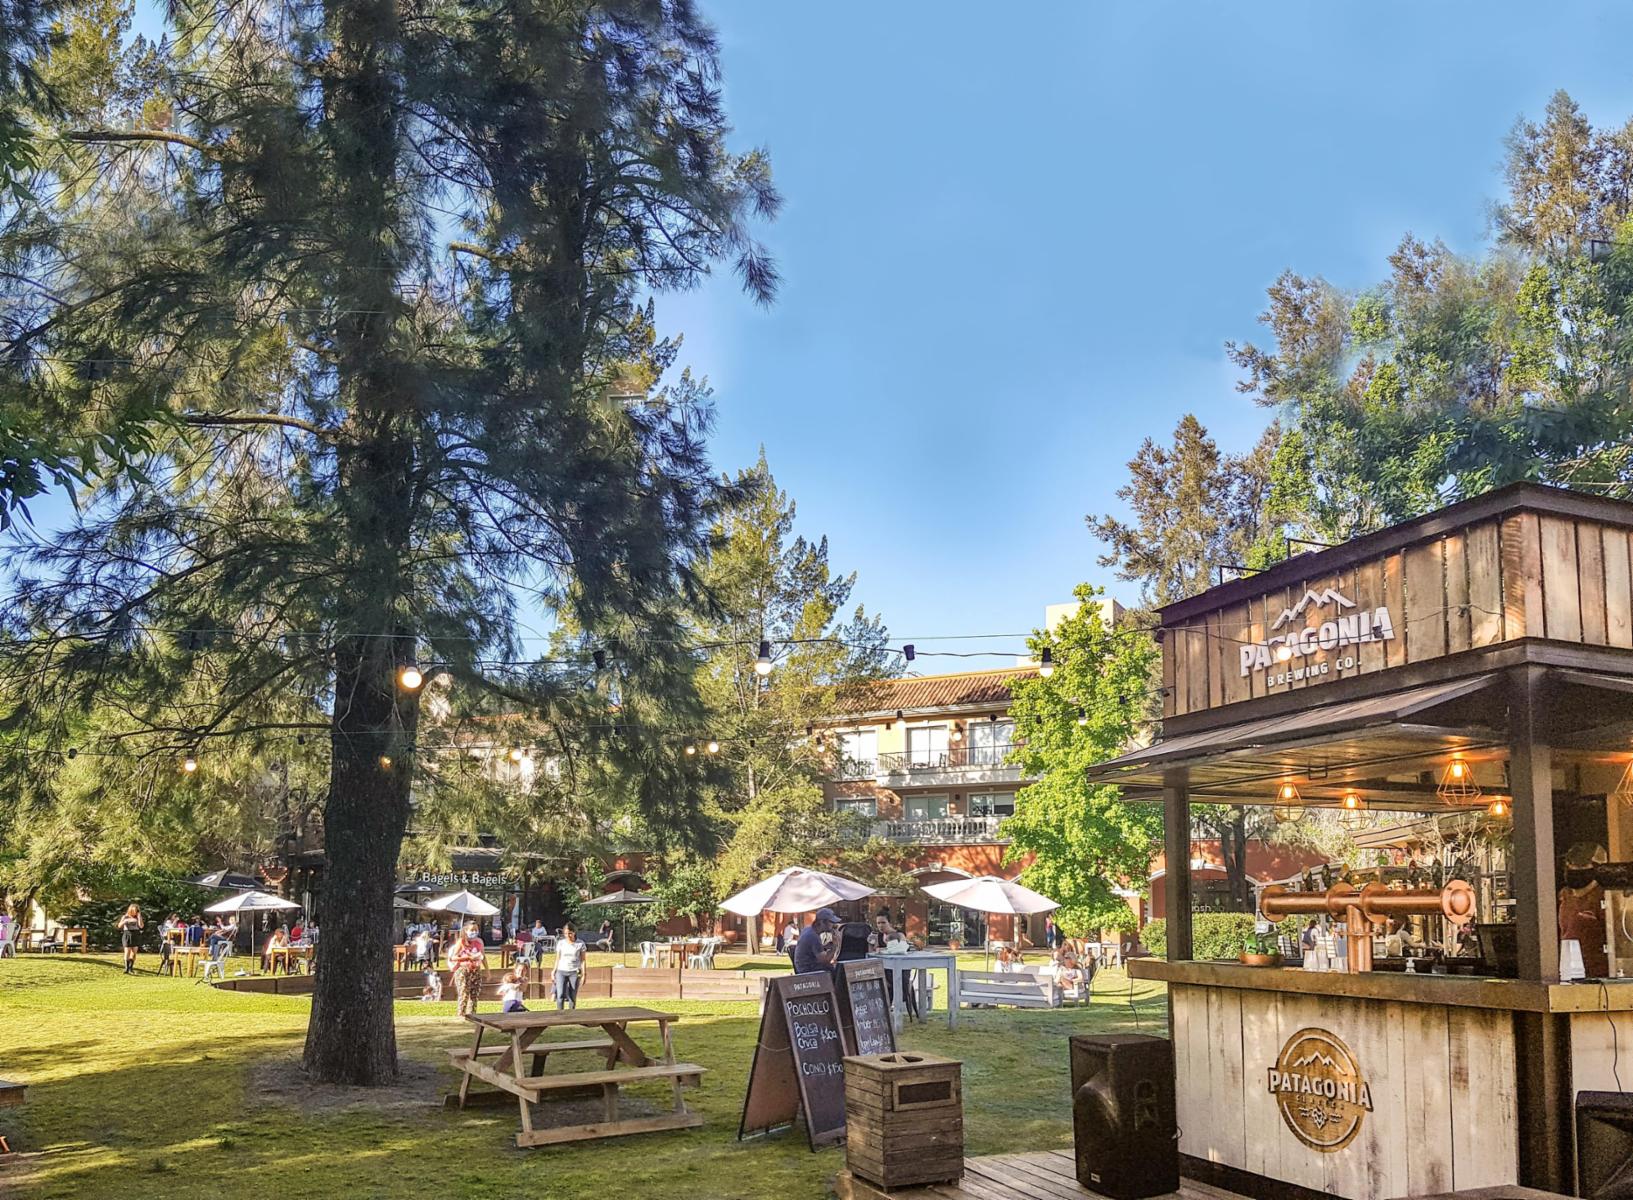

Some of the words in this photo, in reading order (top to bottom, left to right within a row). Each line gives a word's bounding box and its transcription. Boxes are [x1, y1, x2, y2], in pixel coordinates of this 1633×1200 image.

[1239, 606, 1396, 678] PATAGONIA
[1267, 661, 1329, 688] BREWING
[422, 871, 459, 886] Bagels
[461, 873, 469, 884] &
[472, 872, 507, 887] Bagels
[1268, 1069, 1373, 1110] PATAGONIA
